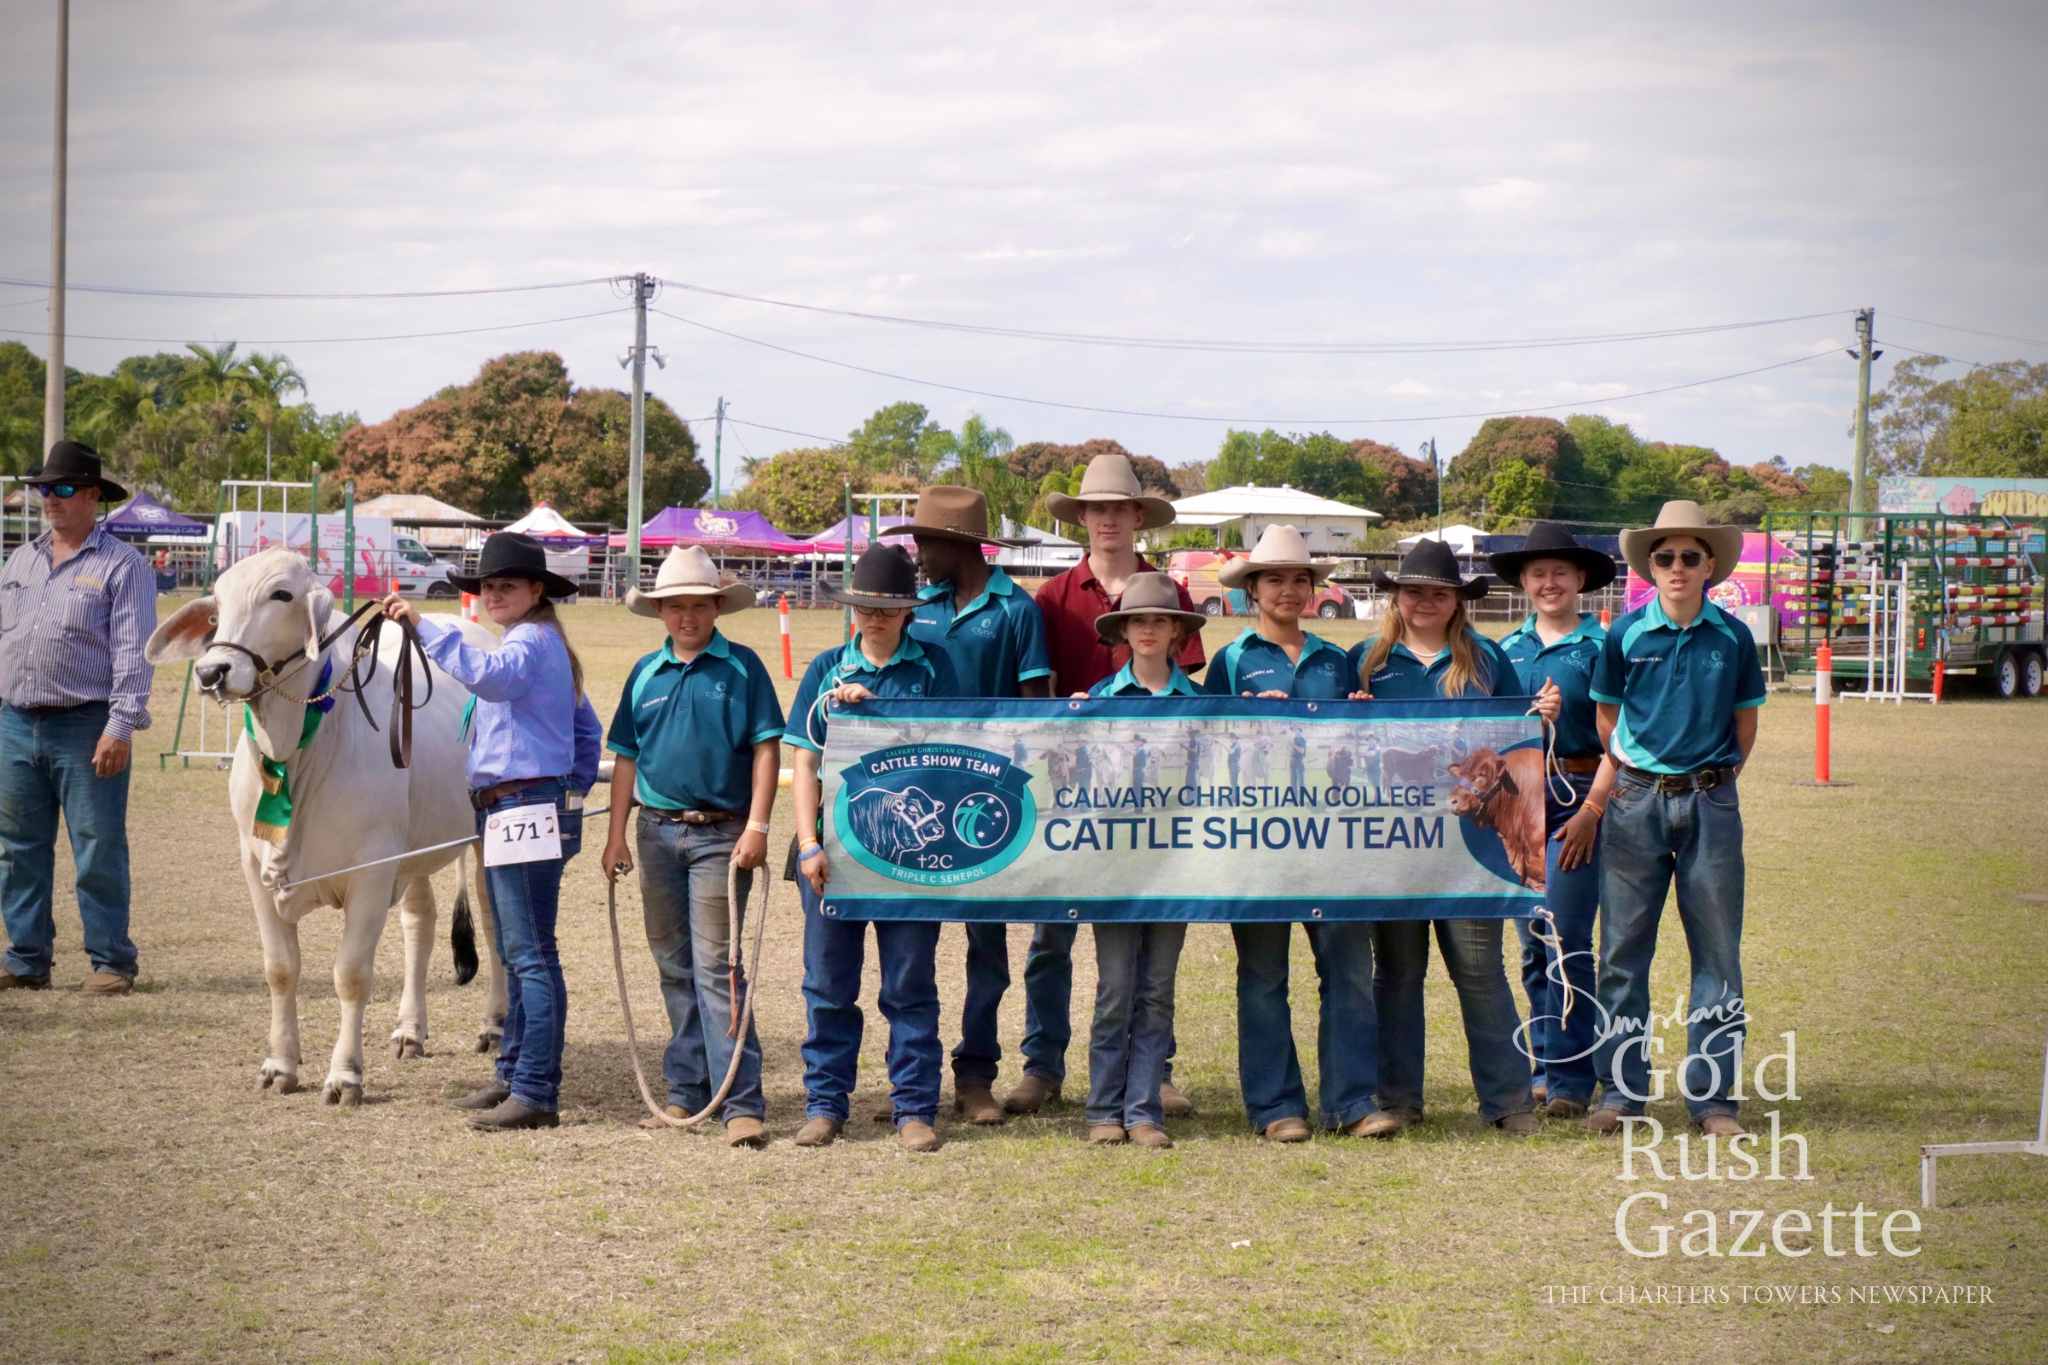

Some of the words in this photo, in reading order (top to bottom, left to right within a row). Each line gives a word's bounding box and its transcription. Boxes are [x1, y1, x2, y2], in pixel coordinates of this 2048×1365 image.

[885, 747, 916, 758] CALVARY
[956, 748, 987, 760] COLLEGE
[870, 755, 918, 774] CATTLE
[922, 755, 962, 768] SHOW
[966, 758, 1001, 777] TEAM
[1056, 786, 1172, 809] CALVARY
[1177, 785, 1317, 808] CHRISTIAN
[1324, 785, 1436, 807] COLLEGE
[502, 822, 540, 843] 171
[1044, 816, 1194, 852] CATTLE
[1202, 816, 1330, 850] SHOW
[1338, 816, 1444, 849] TEAM
[891, 867, 926, 883] TRIPLE
[929, 875, 936, 884] C
[940, 867, 987, 884] SENEPOL
